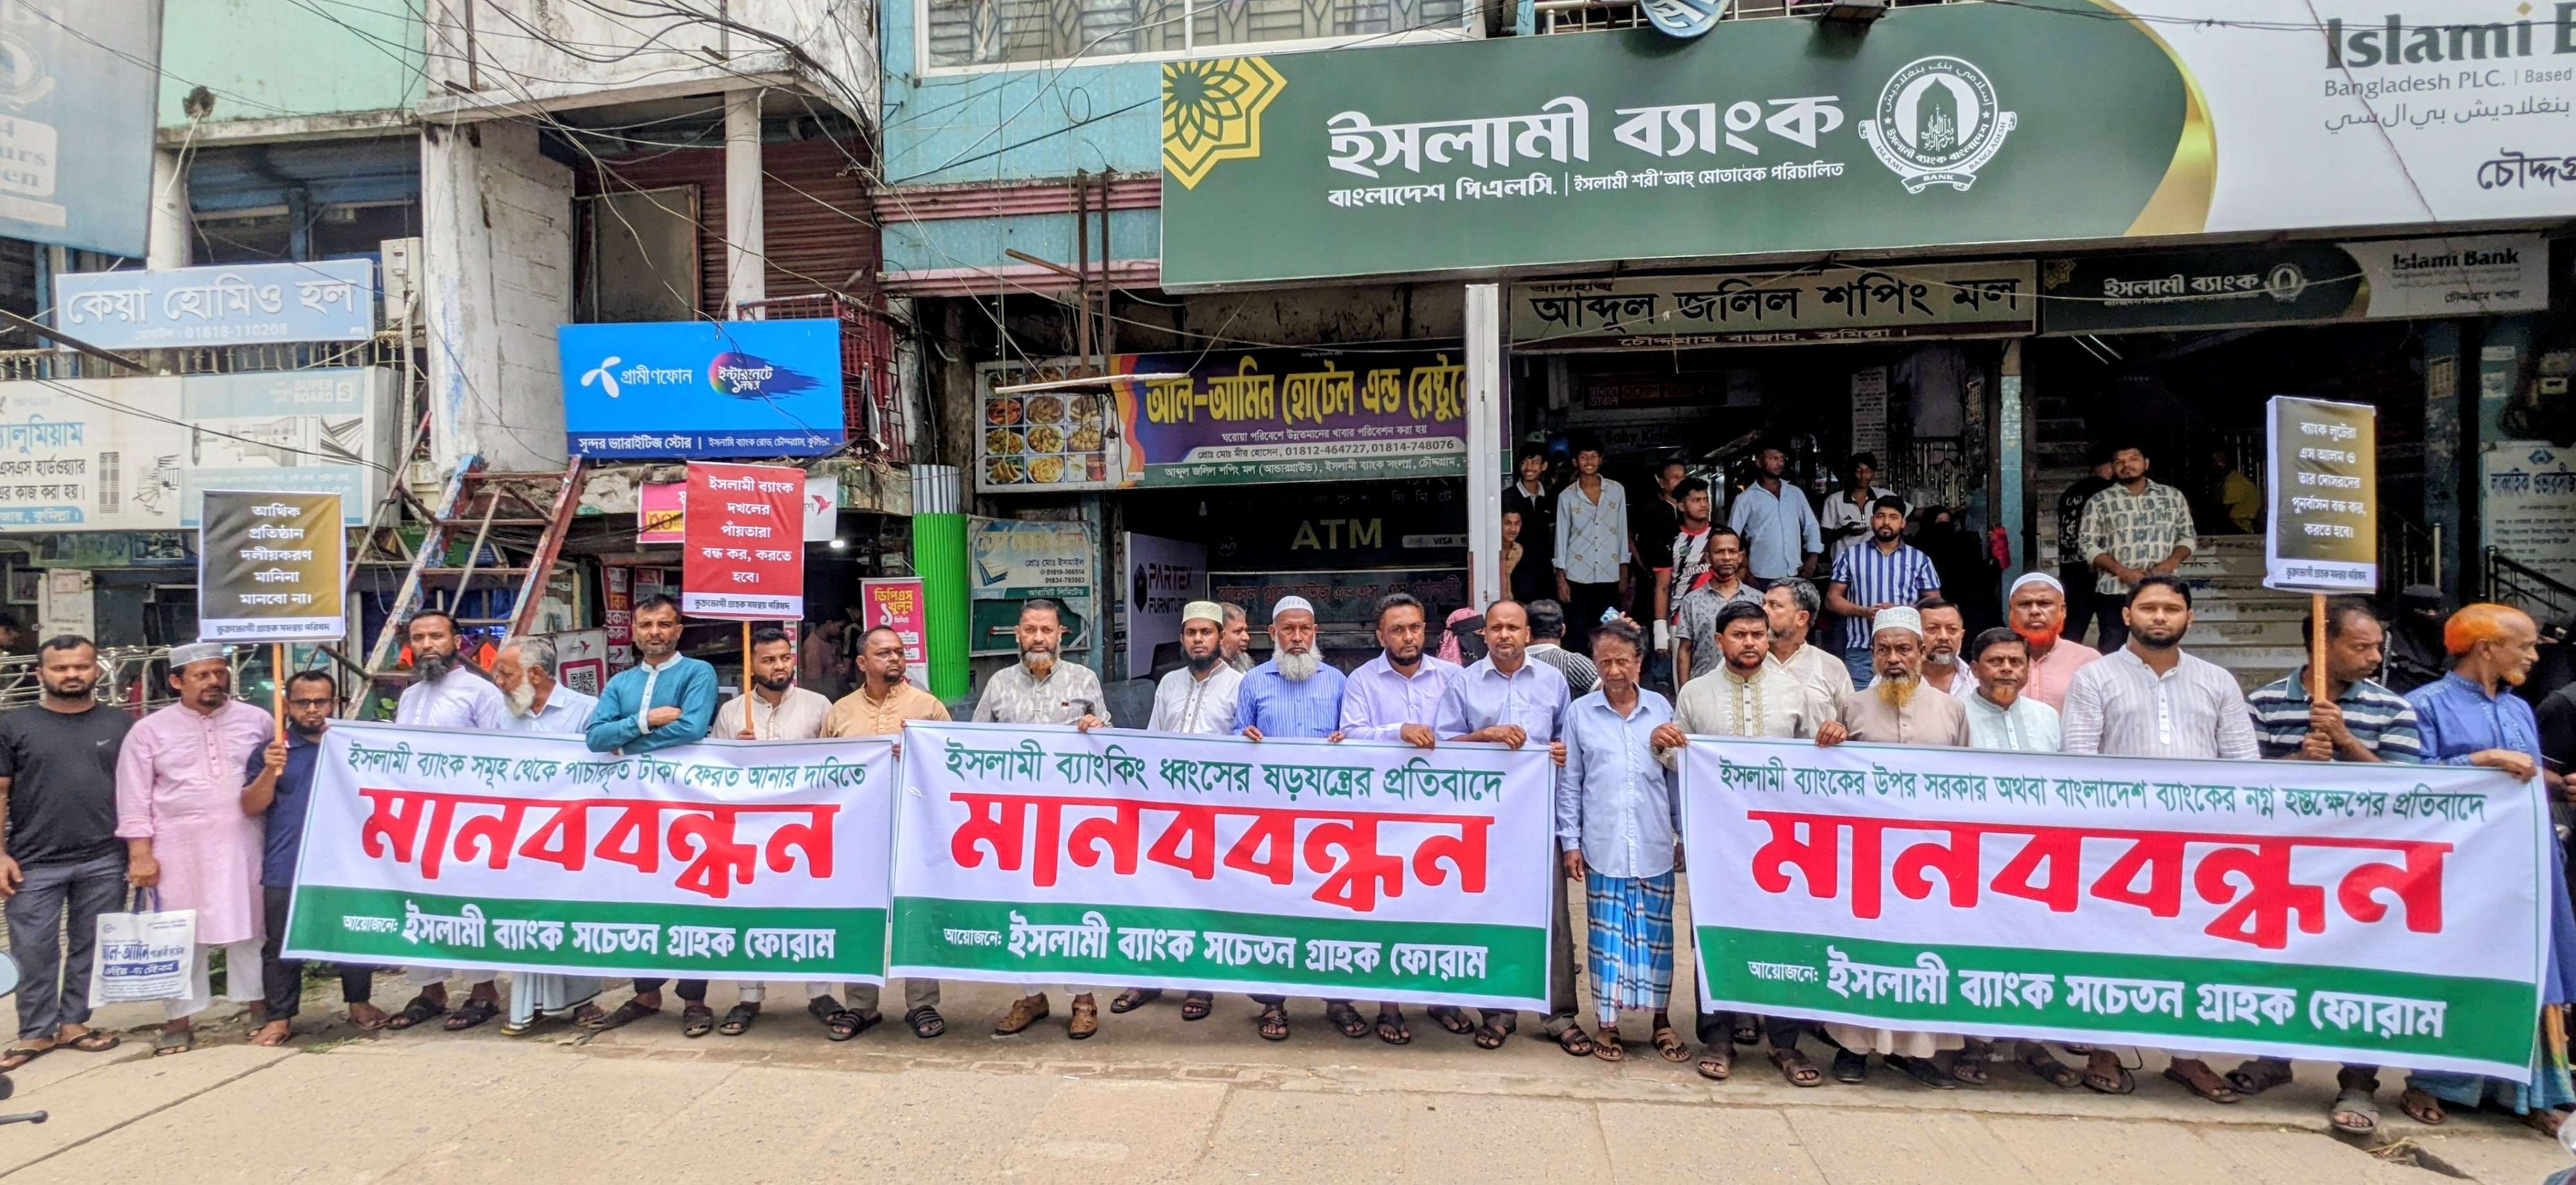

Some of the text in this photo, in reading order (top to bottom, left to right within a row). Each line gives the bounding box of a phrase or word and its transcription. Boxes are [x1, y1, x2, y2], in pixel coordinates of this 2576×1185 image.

[2325, 1, 2533, 69] Islami
[2324, 67, 2572, 99] Bangladesh PLC. Based
[1327, 95, 1588, 179] ইসলামী
[1613, 95, 1844, 159] ব্যাংক
[1877, 145, 1903, 172] ISLAMI
[1968, 121, 2006, 170] BANGLADESH
[0, 145, 46, 166] urs
[1916, 154, 1947, 165] ব্যাংক
[1574, 160, 1844, 192] ইসলামী মোতাবেক পরিচালিত
[1328, 172, 1557, 207] বাংলাদেশ পিএলসি.
[2463, 247, 2520, 266] Bank
[2103, 274, 2259, 298] ইসলামী ব্যাংক
[67, 272, 359, 325] কেয়া হোমিও হল
[1673, 272, 2021, 322] জলিল শপিং মল
[185, 323, 287, 339] 01818-110208
[620, 364, 693, 386] গ্রামীণফোন
[294, 379, 334, 391] SUPER
[1146, 355, 1401, 425] আল-আমিন হোটেল এন্ড
[294, 392, 334, 403] BOARD
[1221, 425, 1427, 442] ঘরোয়া পরিবেশে উন্নতমানের খাবার পরিবেশন করা হয়
[2300, 422, 2356, 442] ব্যাংক লুটেরা
[578, 434, 692, 454] সুন্দর ভ্যারাইটিজ স্টোর
[736, 438, 755, 447] ব্যাংক
[1234, 447, 1248, 458] মীর
[1371, 440, 1454, 452] 01814-748076
[2300, 447, 2355, 464] এস আলম ও
[1164, 467, 1189, 479] আব্দুল
[1192, 464, 1216, 476] জলিল
[1218, 464, 1239, 476] শপিং
[1242, 465, 1256, 474] মল
[1324, 459, 1357, 471] ইসলামী
[1360, 461, 1384, 470] ব্যাংক
[708, 476, 794, 494] ইসলামী ব্যাংক
[2298, 472, 2360, 489] তার দোসরদের
[15, 485, 60, 501] কাজ করা
[251, 503, 301, 517] আর্থিক
[726, 502, 771, 515] দখলের
[2292, 495, 2366, 517] পুনর্বাসন বন্ধ কর,
[249, 524, 305, 539] প্রতিষ্ঠান
[721, 521, 771, 539] পাঁয়তারা
[1290, 518, 1382, 550] ATM
[2304, 523, 2332, 537] করতে
[1433, 537, 1453, 545] VISA
[240, 546, 313, 561] দলীয়করণ
[703, 547, 792, 562] বন্ধ কর, করতে
[1058, 558, 1085, 567] ইসমাইল
[254, 569, 300, 583] মানিনা
[732, 571, 759, 584] হবে।
[1149, 563, 1193, 590] PARTEX
[239, 594, 312, 605] মানবো না।
[874, 588, 913, 601] ডিপিএস
[728, 600, 746, 609] গ্রাহক
[888, 601, 914, 615] খুলুন
[257, 624, 278, 633] গ্রাহক
[348, 740, 413, 774] ইসলামী
[417, 751, 467, 779] ব্যাংক
[471, 754, 512, 789] সমূহ
[514, 758, 561, 784] থেকে
[637, 754, 683, 784] টাকা
[684, 763, 744, 788] ফেরত
[748, 763, 800, 790] আনার
[804, 756, 867, 789] দাবিতে
[944, 737, 1506, 803] ইসলামী ব্যাংকিং ধ্বংসের ষড়যন্ত্রের প্রতিবাদে
[1719, 755, 2487, 821] ইসলামী ব্যাংকের উপর সরকার অথবা বাংলাদেশ ব্যাংকের নগ্ন হস্তক্ষেপের প্রতিবাদে
[359, 787, 841, 898] মানববন্ধন
[950, 792, 1495, 913] মানববন্ধন
[1747, 810, 2454, 950] মানববন্ধন
[402, 900, 836, 963] ইসলামী ব্যাংক সচেতন গ্রাহক ফোরাম
[1007, 910, 1488, 981] ইসলামী ব্যাংক সচেতন গ্রাহক ফোরাম
[1826, 945, 2447, 1039] ইসলামী ব্যাংক সচেতন গ্রাহক ফোরাম
